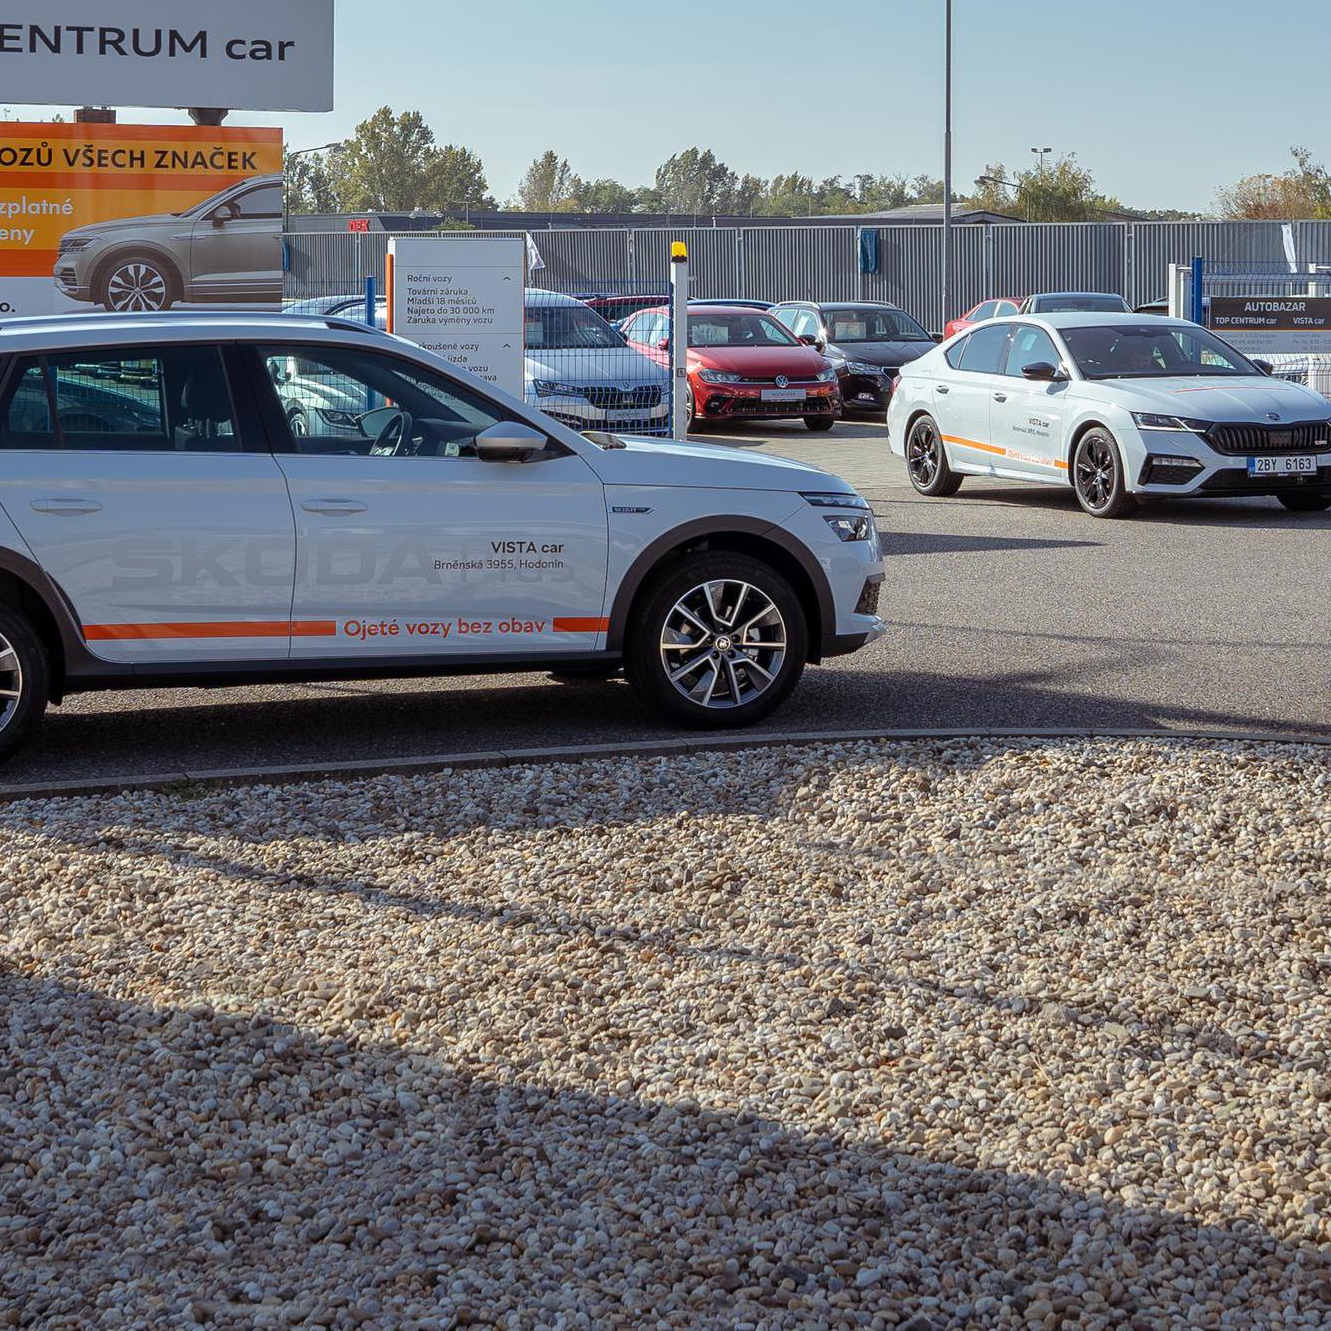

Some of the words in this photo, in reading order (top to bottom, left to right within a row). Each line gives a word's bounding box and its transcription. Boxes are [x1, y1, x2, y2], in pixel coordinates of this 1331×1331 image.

[225, 37, 295, 61] car
[63, 144, 145, 169] VŠECH
[154, 147, 258, 170] ZNAČEK
[432, 276, 453, 284] vozy
[437, 307, 448, 315] do
[481, 307, 495, 315] km
[1244, 301, 1307, 312] AUTOBAZAR
[1215, 317, 1230, 325] TOP
[1231, 317, 1265, 325] CENTRUM
[1293, 317, 1313, 325] VISTA
[460, 343, 480, 352] vozy
[1257, 458, 1277, 470] 2BY
[1285, 458, 1312, 470] 6163
[491, 541, 538, 554] VISTA
[541, 545, 565, 554] car
[434, 559, 484, 570] Brněnská
[486, 559, 517, 571] 3955,
[519, 559, 564, 569] Hodonín
[343, 619, 400, 641] Ojeté
[405, 626, 452, 639] vozy
[457, 617, 493, 635] bez
[498, 617, 546, 635] obav
